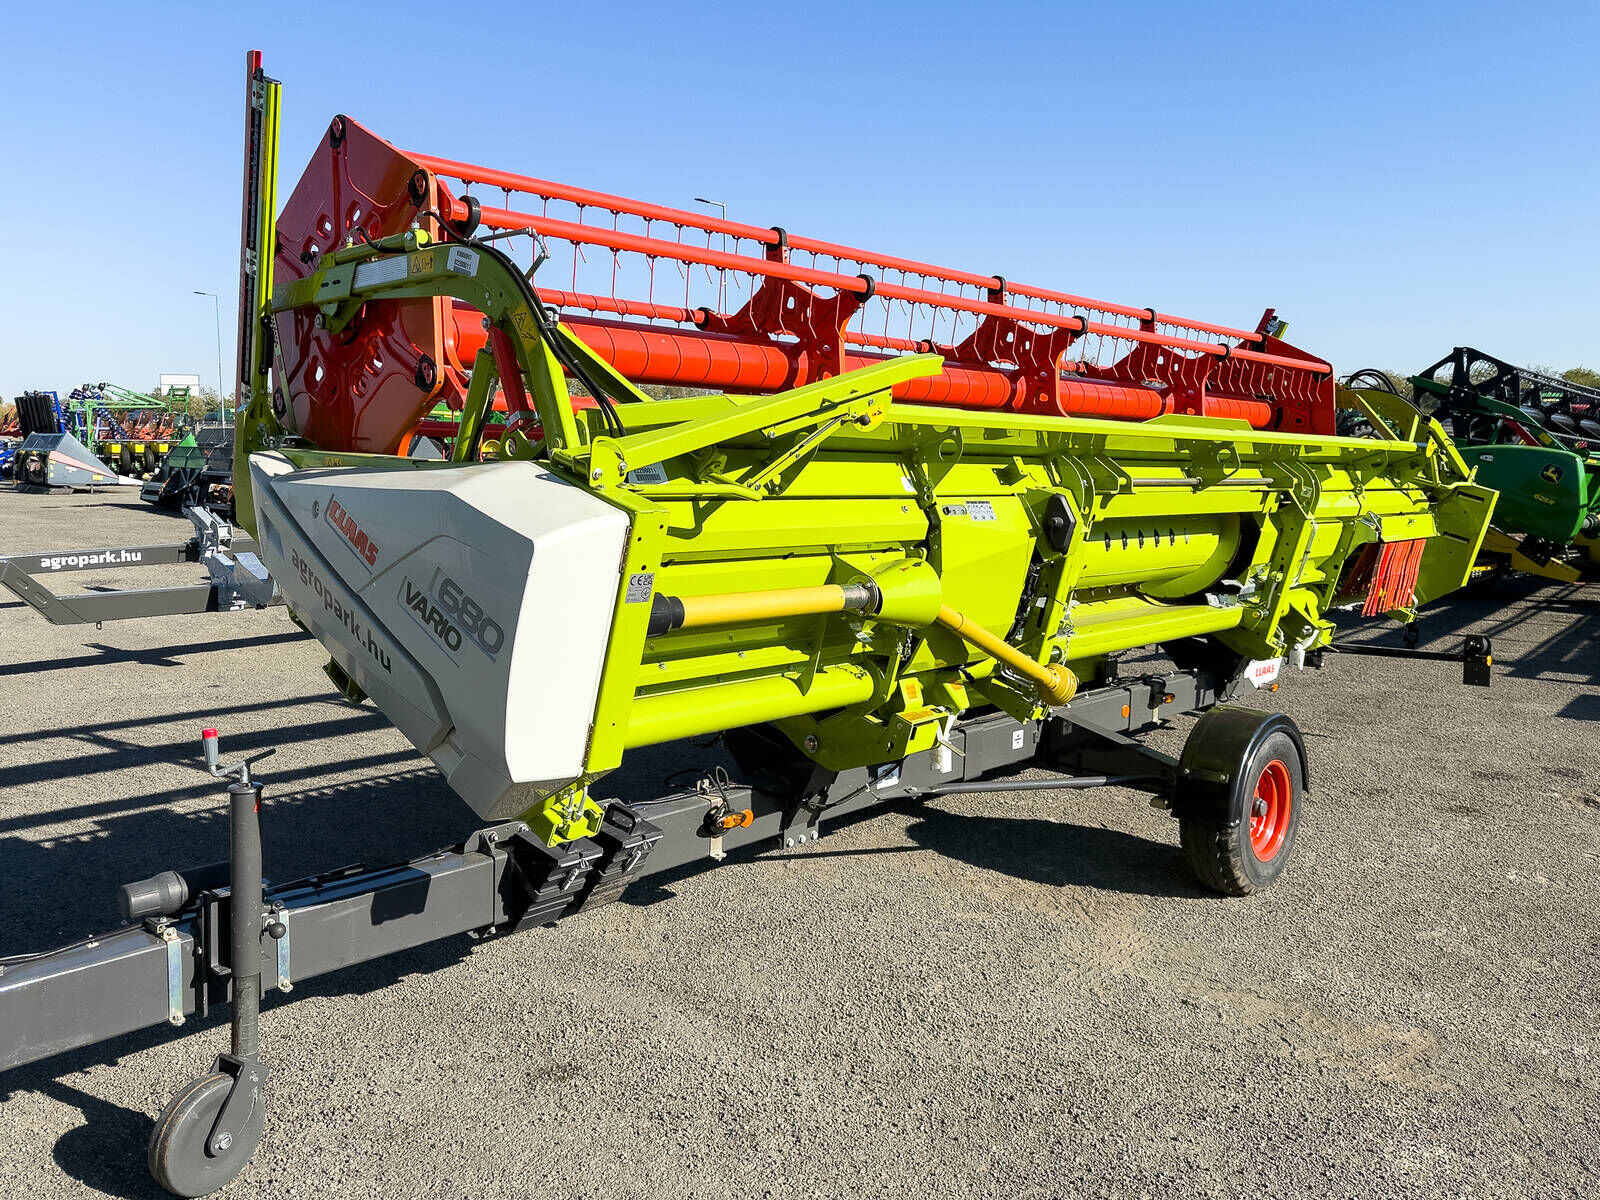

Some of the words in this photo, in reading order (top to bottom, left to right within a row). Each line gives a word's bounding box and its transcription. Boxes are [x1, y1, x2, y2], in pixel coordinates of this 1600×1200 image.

[40, 550, 142, 569] agropark.hu
[328, 500, 379, 567] CLAAS
[291, 548, 392, 674] agropark.hu
[405, 580, 463, 652] VARIO
[438, 577, 505, 655] 680
[1255, 664, 1275, 677] CLAAS
